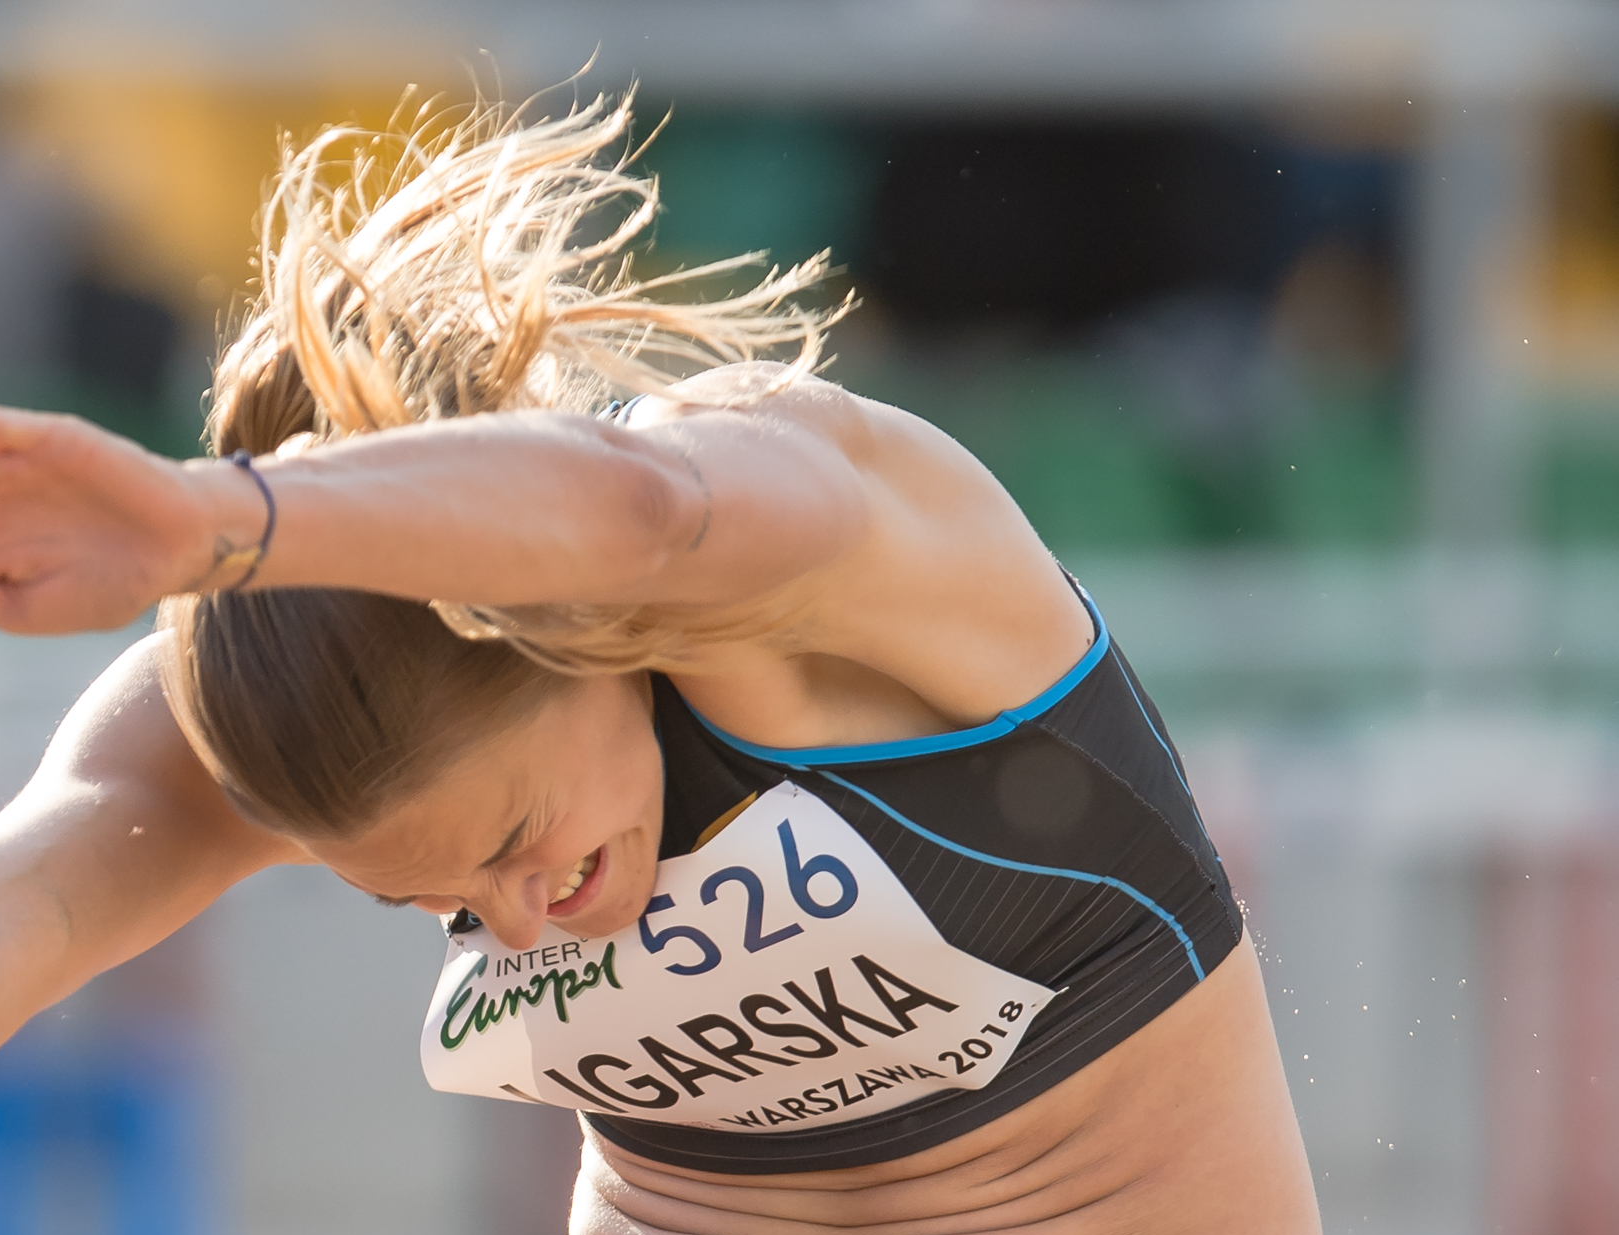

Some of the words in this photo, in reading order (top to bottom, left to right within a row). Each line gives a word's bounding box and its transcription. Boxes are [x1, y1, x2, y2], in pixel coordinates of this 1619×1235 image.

[638, 817, 859, 976] 526
[440, 941, 623, 1050] Europol
[496, 941, 582, 977] INTER
[719, 1063, 948, 1128] WARSZAWA
[938, 1000, 1024, 1075] 2018
